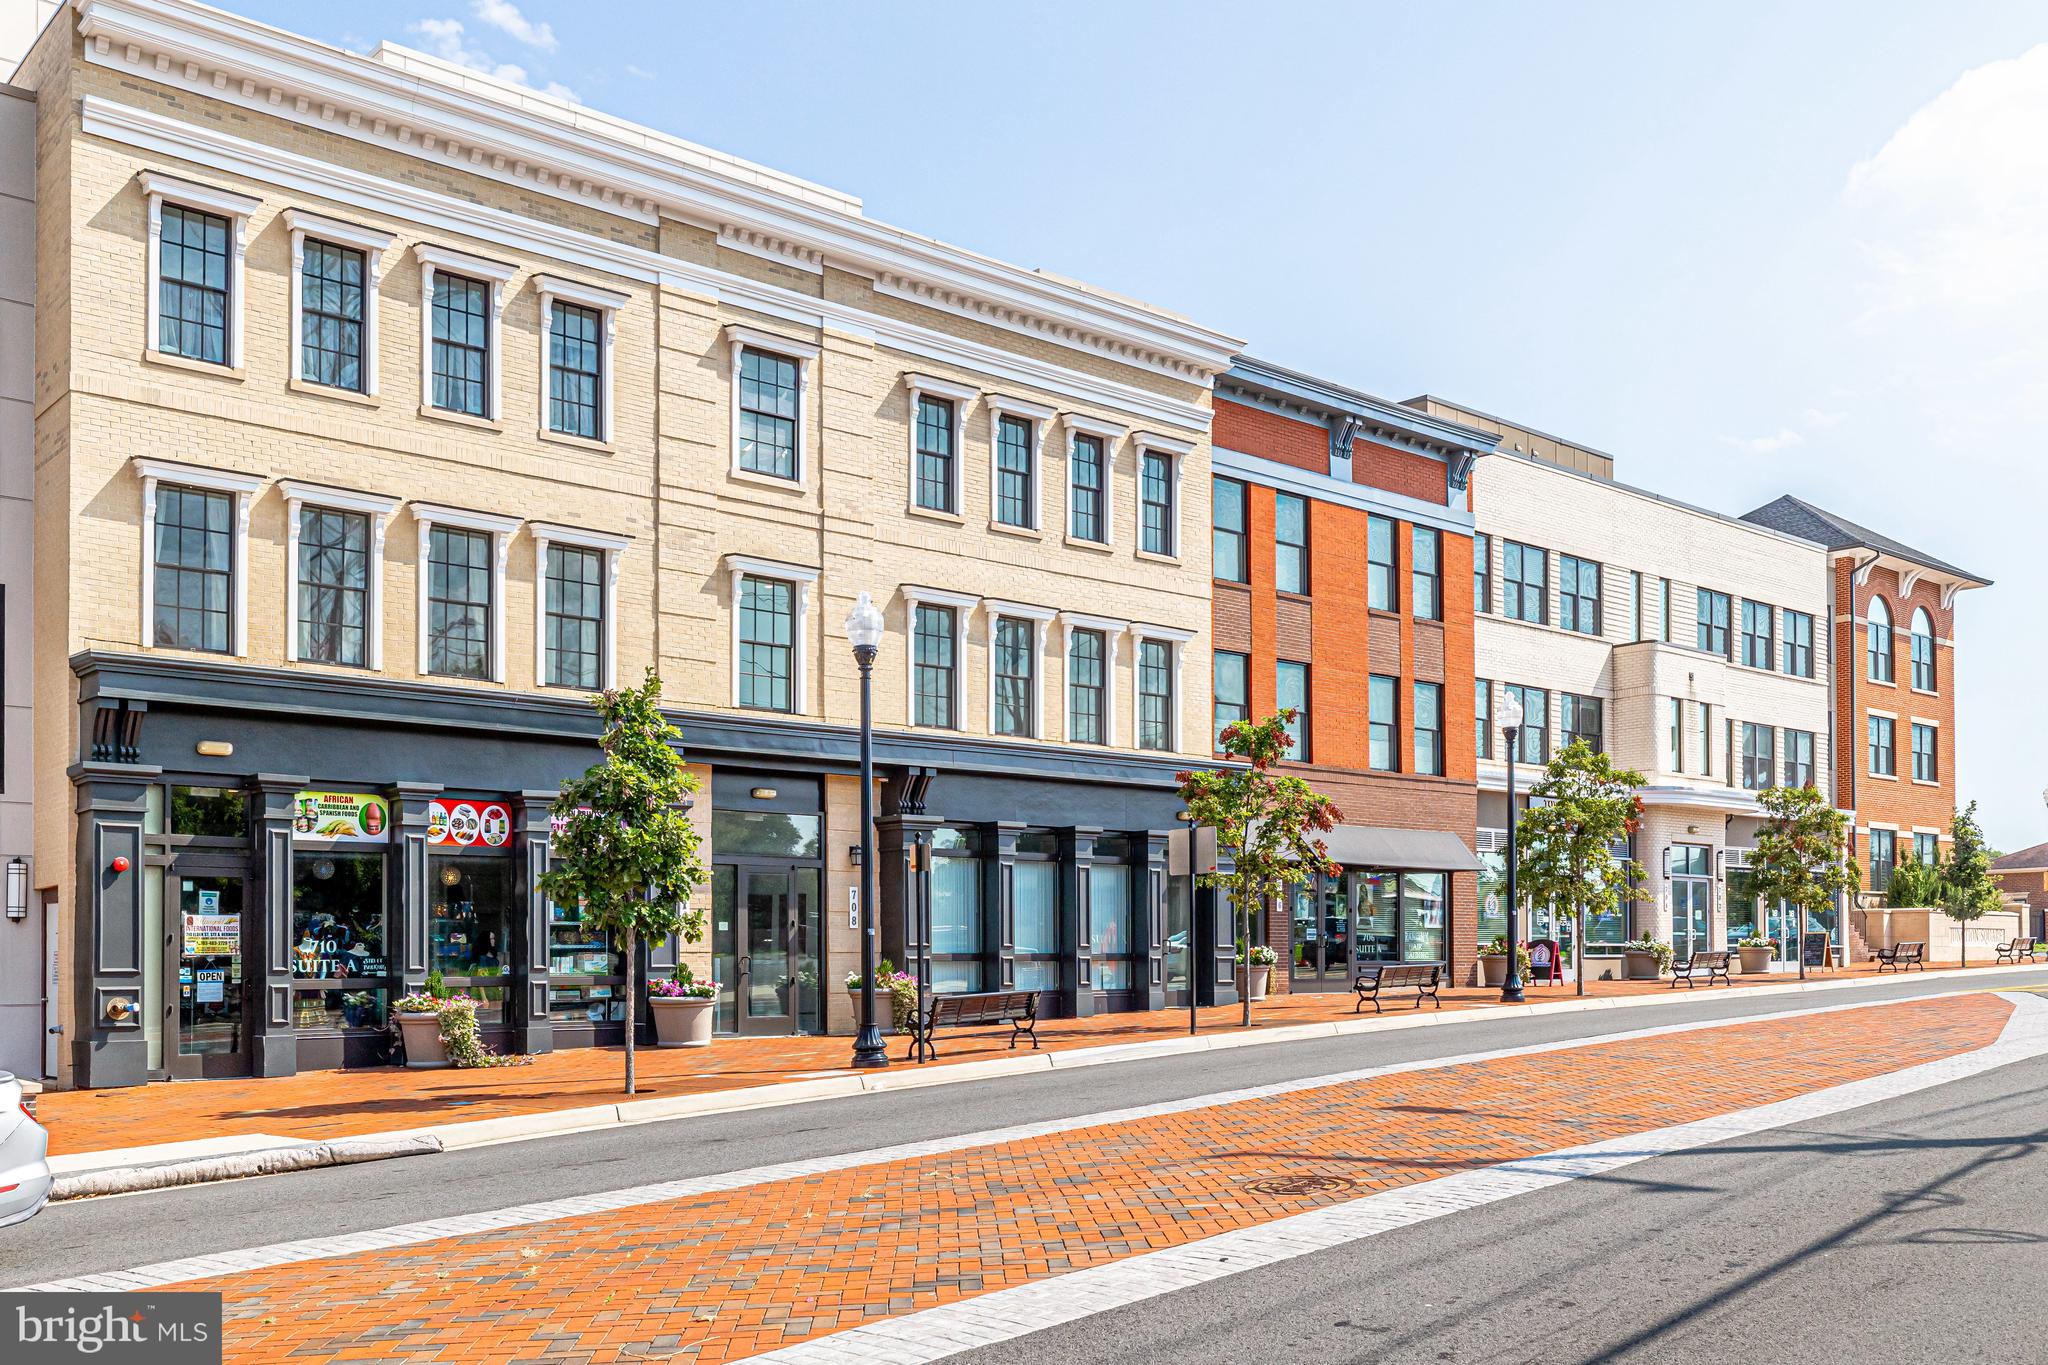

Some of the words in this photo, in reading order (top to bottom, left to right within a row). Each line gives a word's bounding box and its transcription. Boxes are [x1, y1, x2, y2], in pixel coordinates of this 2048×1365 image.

[323, 794, 354, 804] AFRICAN
[319, 809, 341, 817] SPANISH
[341, 810, 358, 818] FOODS
[1950, 927, 1979, 942] JUNTION
[310, 940, 338, 954] 710
[1355, 943, 1376, 954] SUITE
[292, 958, 340, 973] SUITE
[346, 958, 358, 973] A
[199, 972, 223, 982] OPEN
